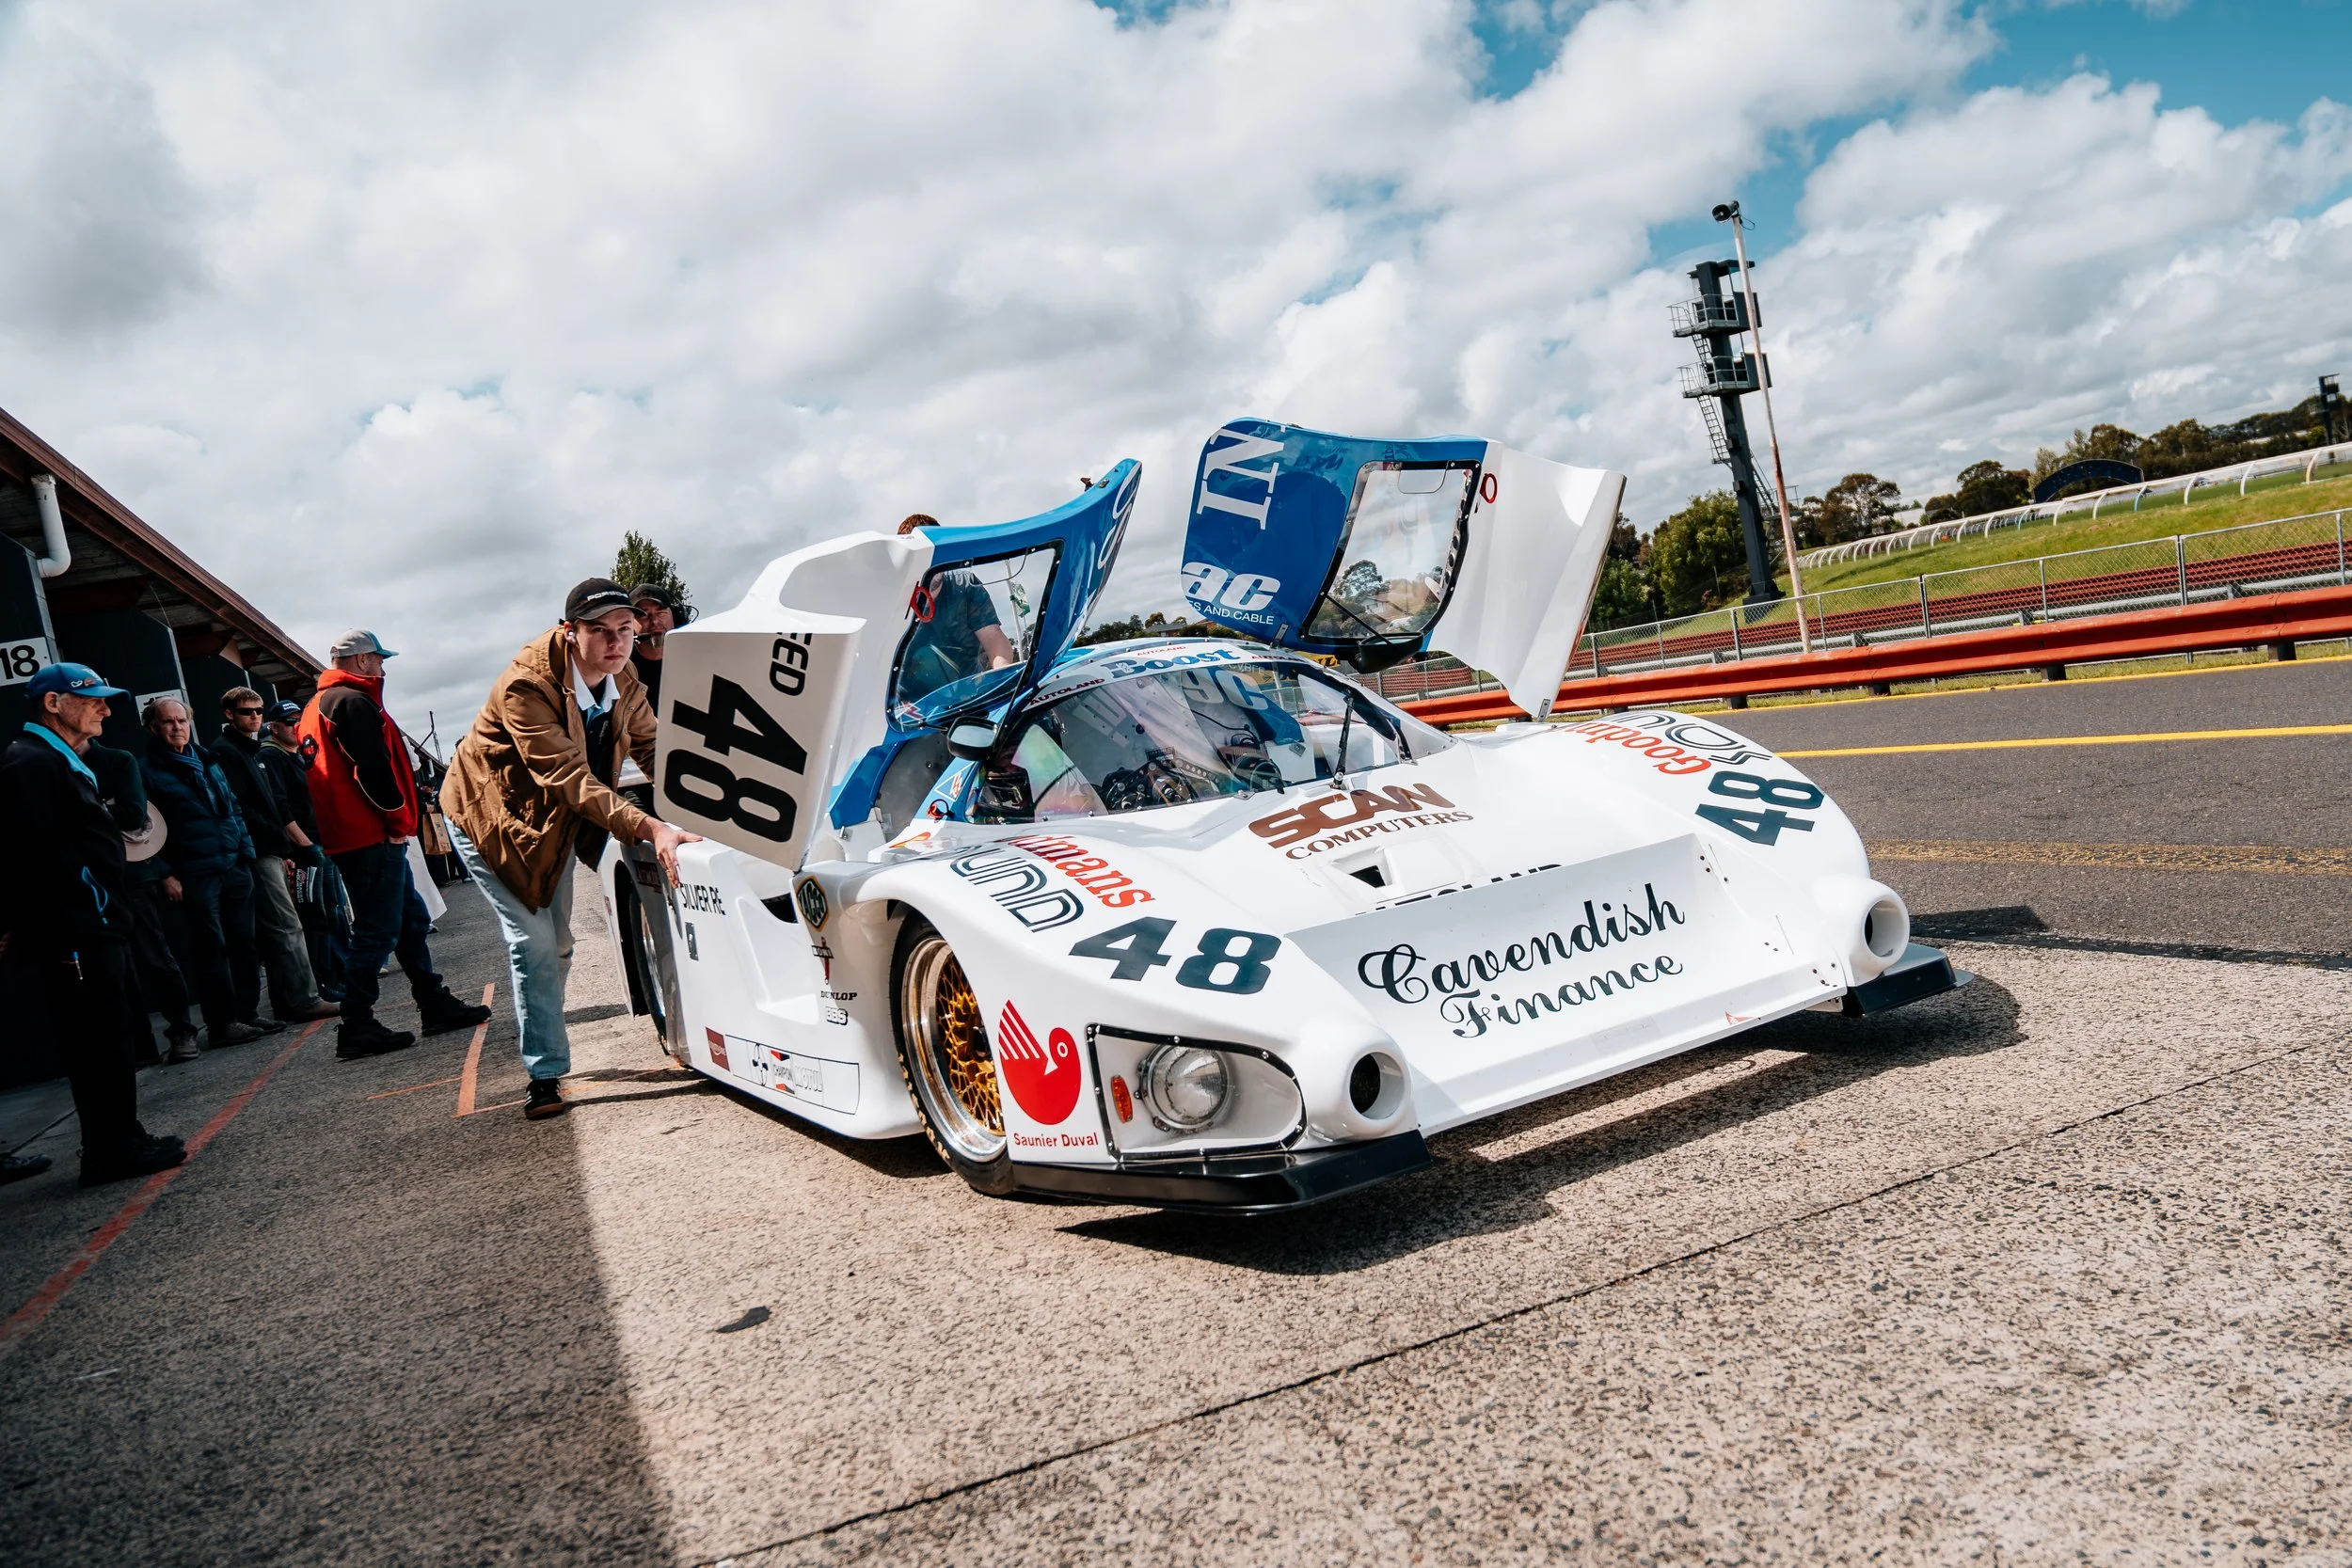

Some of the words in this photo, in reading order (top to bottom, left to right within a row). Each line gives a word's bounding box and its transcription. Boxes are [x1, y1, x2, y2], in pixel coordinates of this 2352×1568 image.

[1203, 605, 1231, 618] AND
[1233, 610, 1275, 626] CABLE
[0, 644, 40, 679] 18
[1100, 649, 1241, 679] Boost
[1029, 677, 1105, 705] AUTOLAND
[663, 673, 808, 843] 48
[1248, 783, 1456, 849] SCAN
[1694, 769, 1825, 847] 48
[1285, 810, 1474, 860] COMPUTERS
[678, 882, 712, 912] SILVER
[1068, 915, 1282, 995] 48
[1358, 882, 1686, 1005] Cavendish
[820, 990, 858, 1001] DUNLOP
[1439, 955, 1684, 1038] Finance
[825, 1006, 849, 1026] BBS
[1013, 1132, 1058, 1148] Saunier
[1061, 1132, 1100, 1147] Duval
